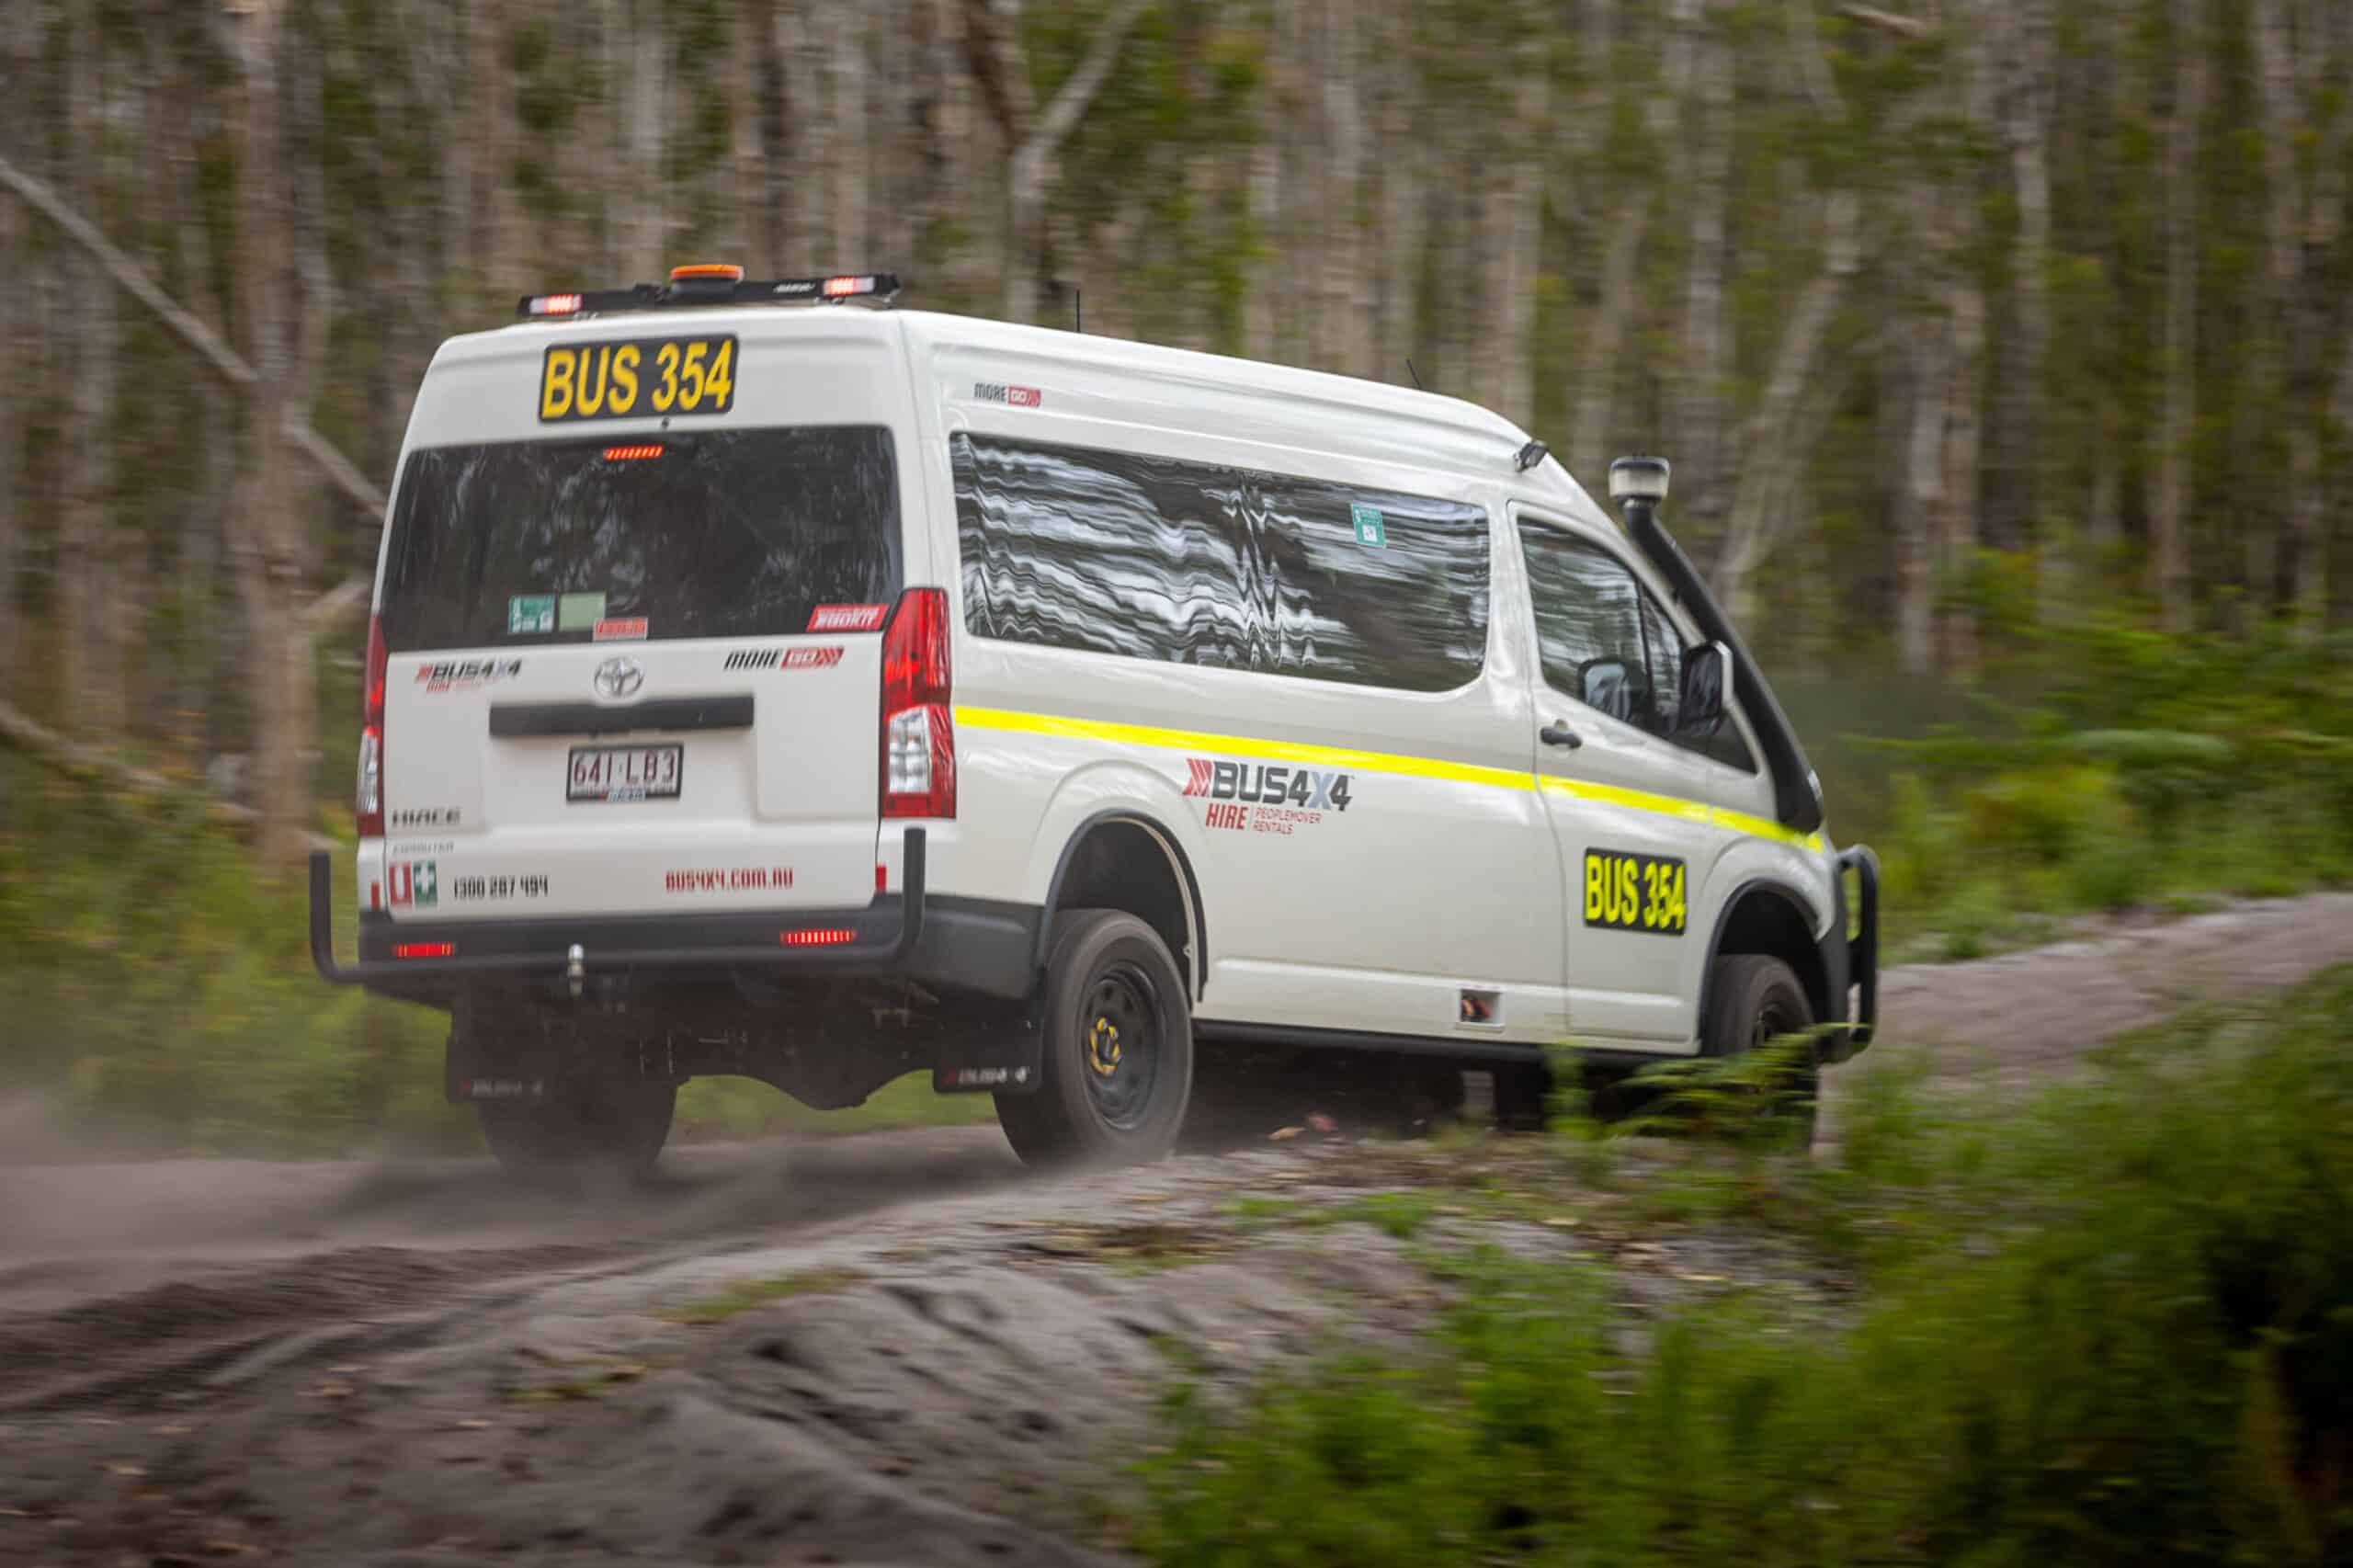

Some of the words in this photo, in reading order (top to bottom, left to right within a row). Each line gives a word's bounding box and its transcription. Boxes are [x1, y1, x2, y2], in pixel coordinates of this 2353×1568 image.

[541, 343, 641, 420] BUS
[652, 338, 733, 413] 354
[1211, 760, 1352, 812] BUS4X4
[1205, 802, 1249, 831] HIRE
[1255, 806, 1322, 824] PEOPLEMOVER
[1253, 820, 1294, 835] RENTALS
[1585, 854, 1639, 925] BUS
[1643, 861, 1686, 930] 354
